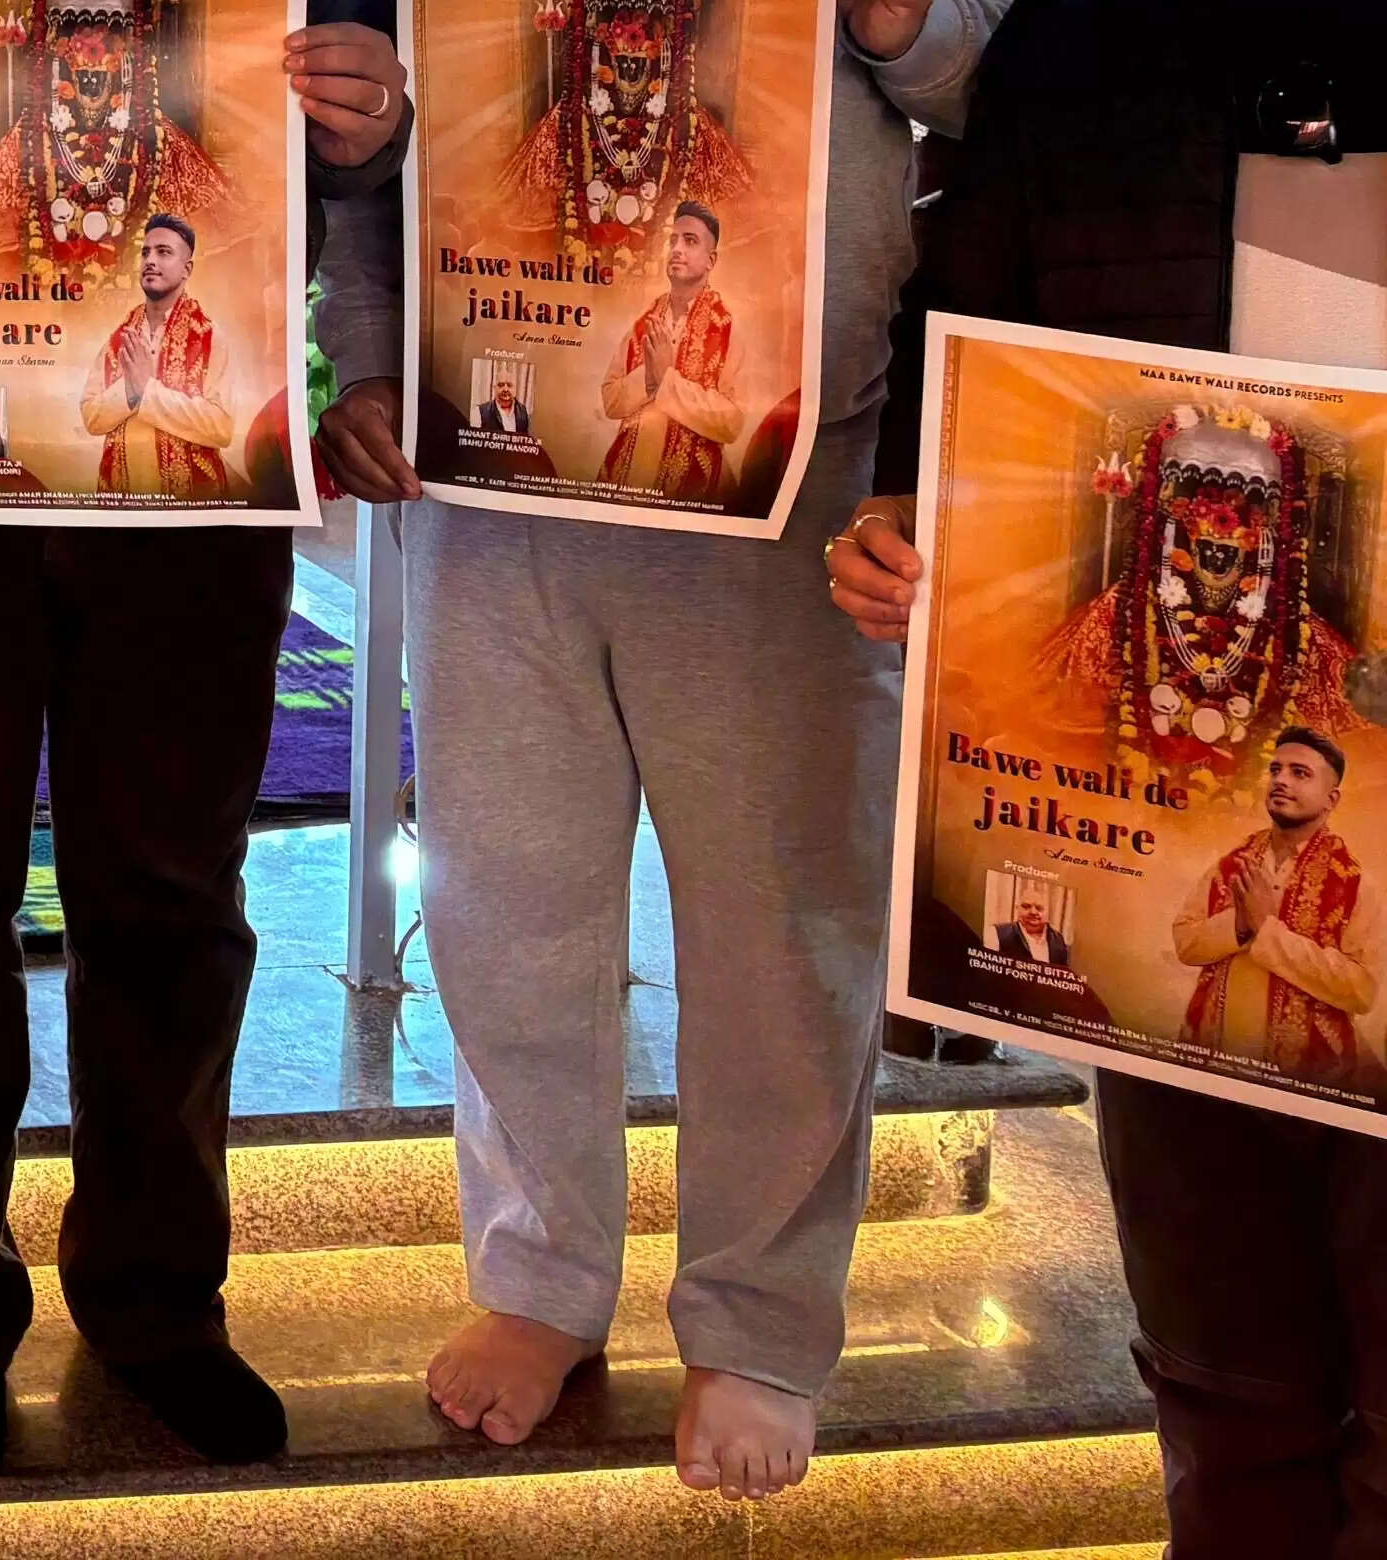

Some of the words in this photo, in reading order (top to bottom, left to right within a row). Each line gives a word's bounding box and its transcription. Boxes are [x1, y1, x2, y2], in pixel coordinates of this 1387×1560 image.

[440, 247, 511, 278] Bawe
[519, 253, 575, 283] wali
[582, 256, 613, 286] de
[50, 273, 83, 301] de
[462, 287, 590, 328] jaikare
[17, 354, 55, 365] Sharma
[484, 347, 525, 358] Producer
[1140, 368, 1165, 380] MAA
[1170, 372, 1200, 385] BAWE
[1205, 377, 1234, 389] WALI
[1237, 381, 1291, 398] RECORDS
[1294, 389, 1343, 403] PRESENTS
[948, 731, 1043, 784] Bawe
[1052, 763, 1131, 800] wali
[1144, 773, 1188, 811] de
[974, 786, 1157, 855] jaikare
[1004, 859, 1060, 881] Producer
[1042, 845, 1087, 866] Aman
[1094, 857, 1144, 877] Sharma
[967, 947, 1012, 966] MAHANT
[1014, 959, 1042, 973] SHRI
[1043, 966, 1077, 981] BITTA
[1076, 973, 1088, 983] JI
[968, 957, 1003, 973] (BAHU
[1004, 966, 1035, 982] FORT
[1035, 975, 1086, 995] MANDIR)
